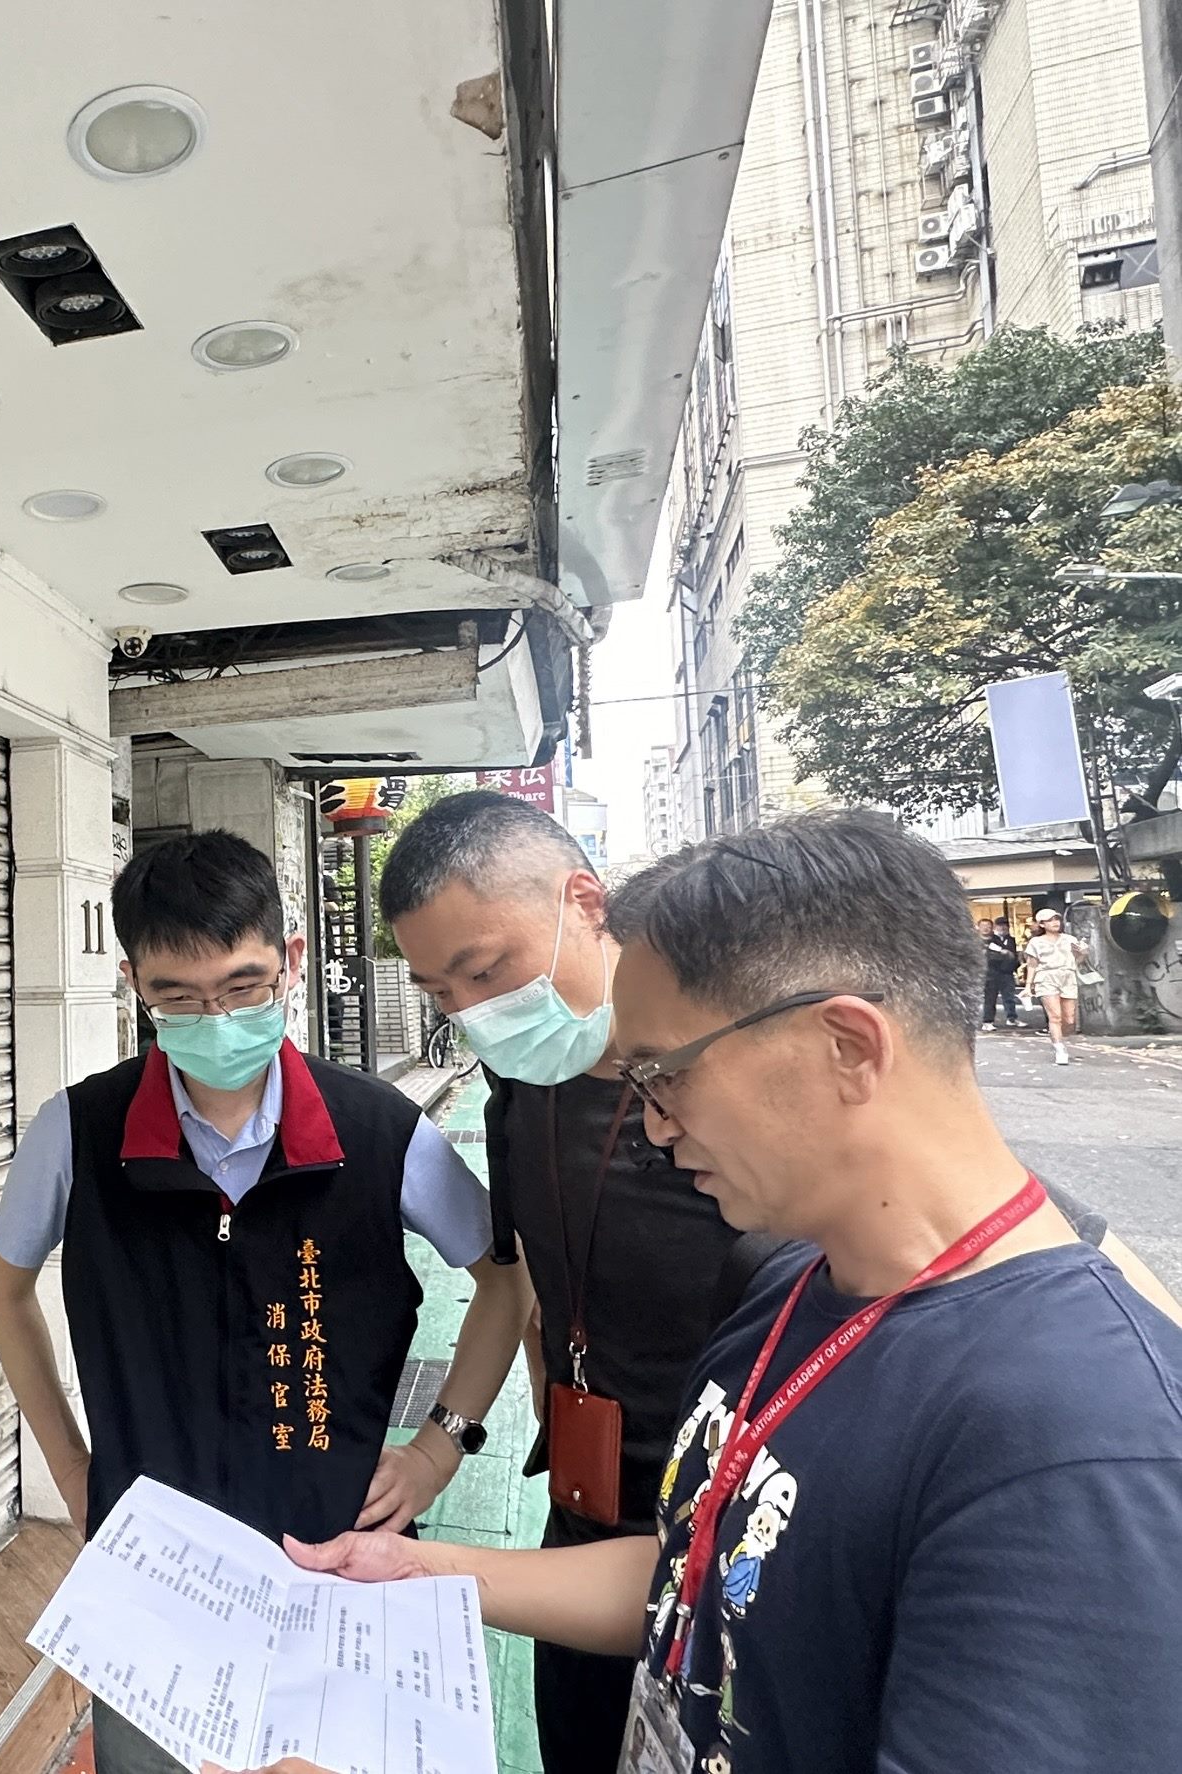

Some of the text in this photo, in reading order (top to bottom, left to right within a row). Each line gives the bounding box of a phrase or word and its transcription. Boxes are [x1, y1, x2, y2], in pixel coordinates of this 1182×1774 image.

[80, 899, 108, 955] 11
[961, 1217, 1005, 1253] SERVICE
[266, 1303, 294, 1451] 消保官室
[297, 1238, 333, 1451] 臺北市政府法務局
[749, 1396, 788, 1441] NATIONAL
[785, 1353, 827, 1400] ACADEMY
[824, 1342, 839, 1359] OF
[838, 1323, 864, 1346] CIVIL
